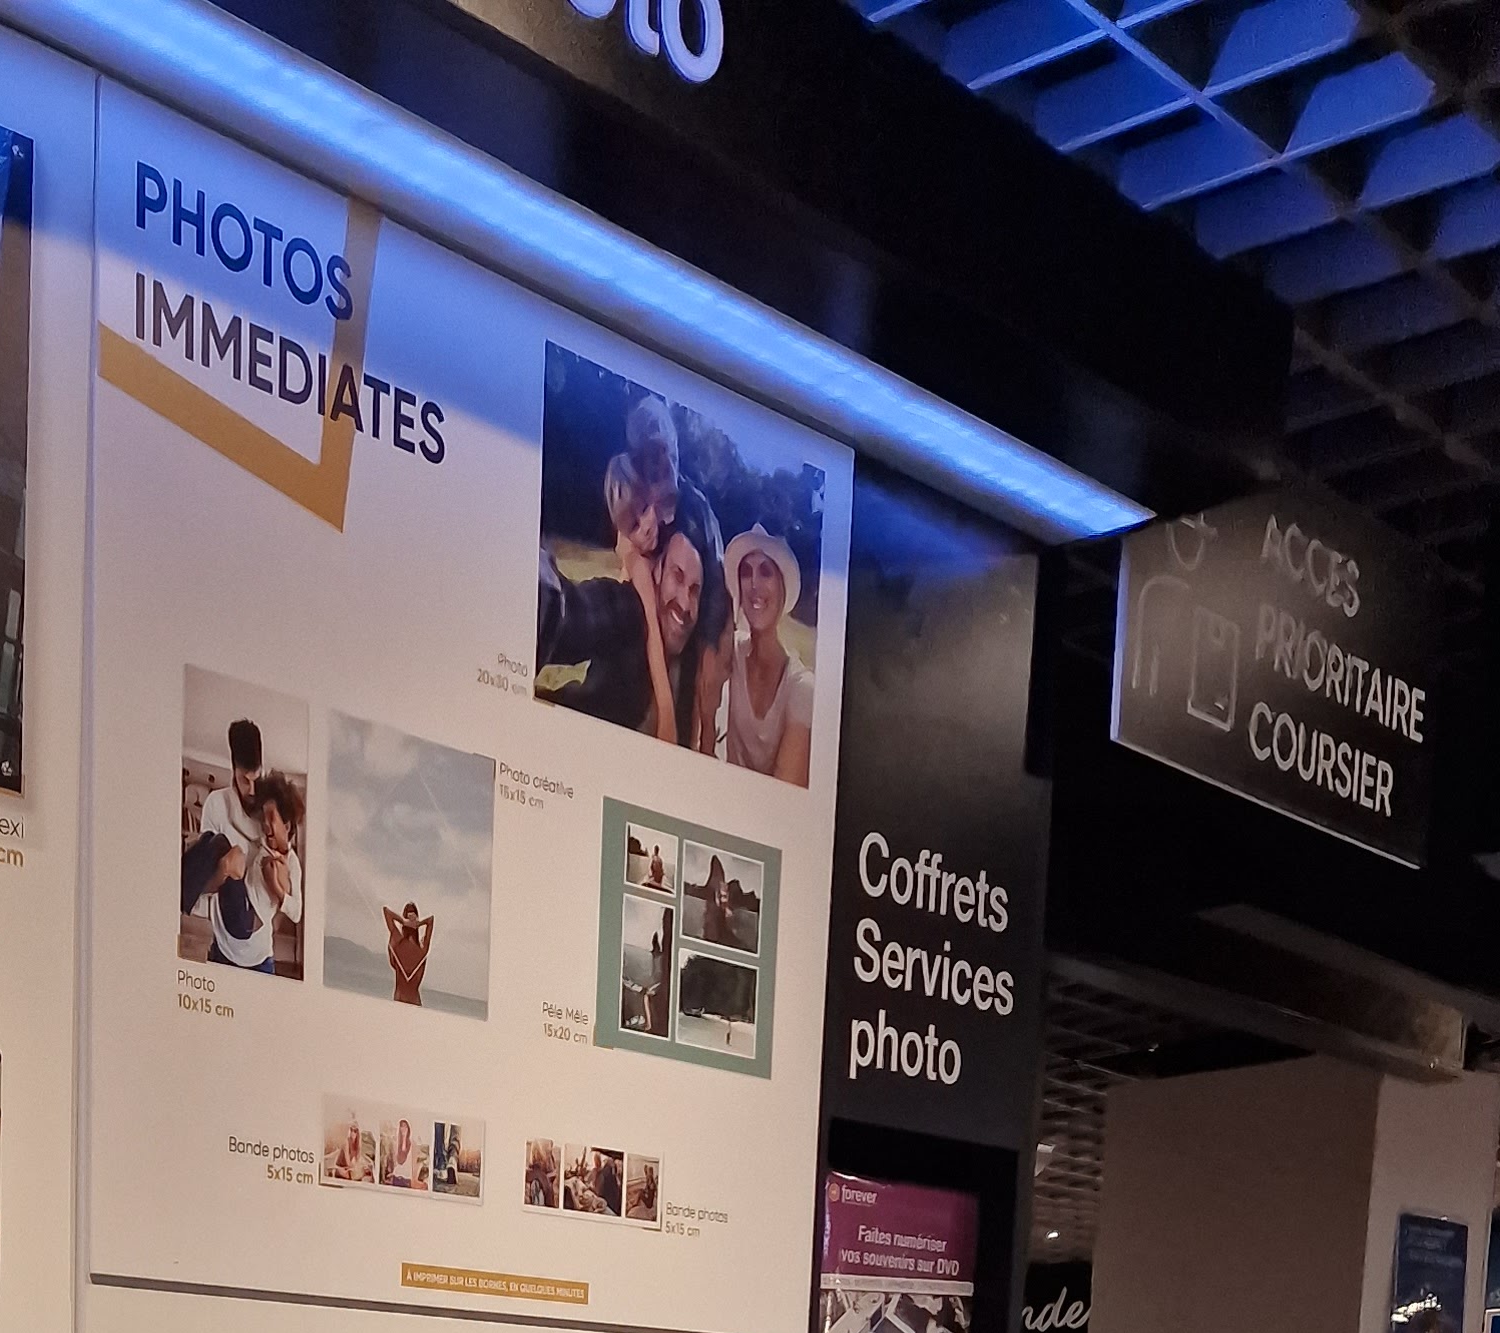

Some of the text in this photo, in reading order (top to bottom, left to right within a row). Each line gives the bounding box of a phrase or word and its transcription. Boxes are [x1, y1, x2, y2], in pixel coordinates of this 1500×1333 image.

[135, 160, 353, 321] PHOTOS
[135, 271, 446, 465] IMMEDIATES
[497, 653, 528, 677] Photo
[1255, 603, 1426, 743] PRIORITAIRE
[1248, 701, 1394, 817] COURSIER
[500, 761, 574, 800] Photo créative
[528, 795, 544, 809] cm
[858, 832, 1009, 933] Coffrets
[853, 917, 1014, 1016] Services
[177, 969, 216, 993] Photo
[177, 993, 234, 1018] 10x15 cm
[542, 1001, 589, 1026] Pêle Mêle
[543, 1022, 588, 1044] 15x20 cm
[848, 1008, 962, 1085] photo
[228, 1136, 315, 1164] Bande photos
[267, 1164, 314, 1185] 5x15 cm
[841, 1184, 878, 1204] forever
[666, 1201, 696, 1219] Bande
[665, 1220, 685, 1236] 5x15
[857, 1224, 892, 1246] Faites
[840, 1248, 960, 1277] vos souvenirs sur DVD
[413, 1271, 449, 1285] IMPRIMER
[449, 1276, 464, 1286] SUR
[465, 1277, 478, 1287] LES
